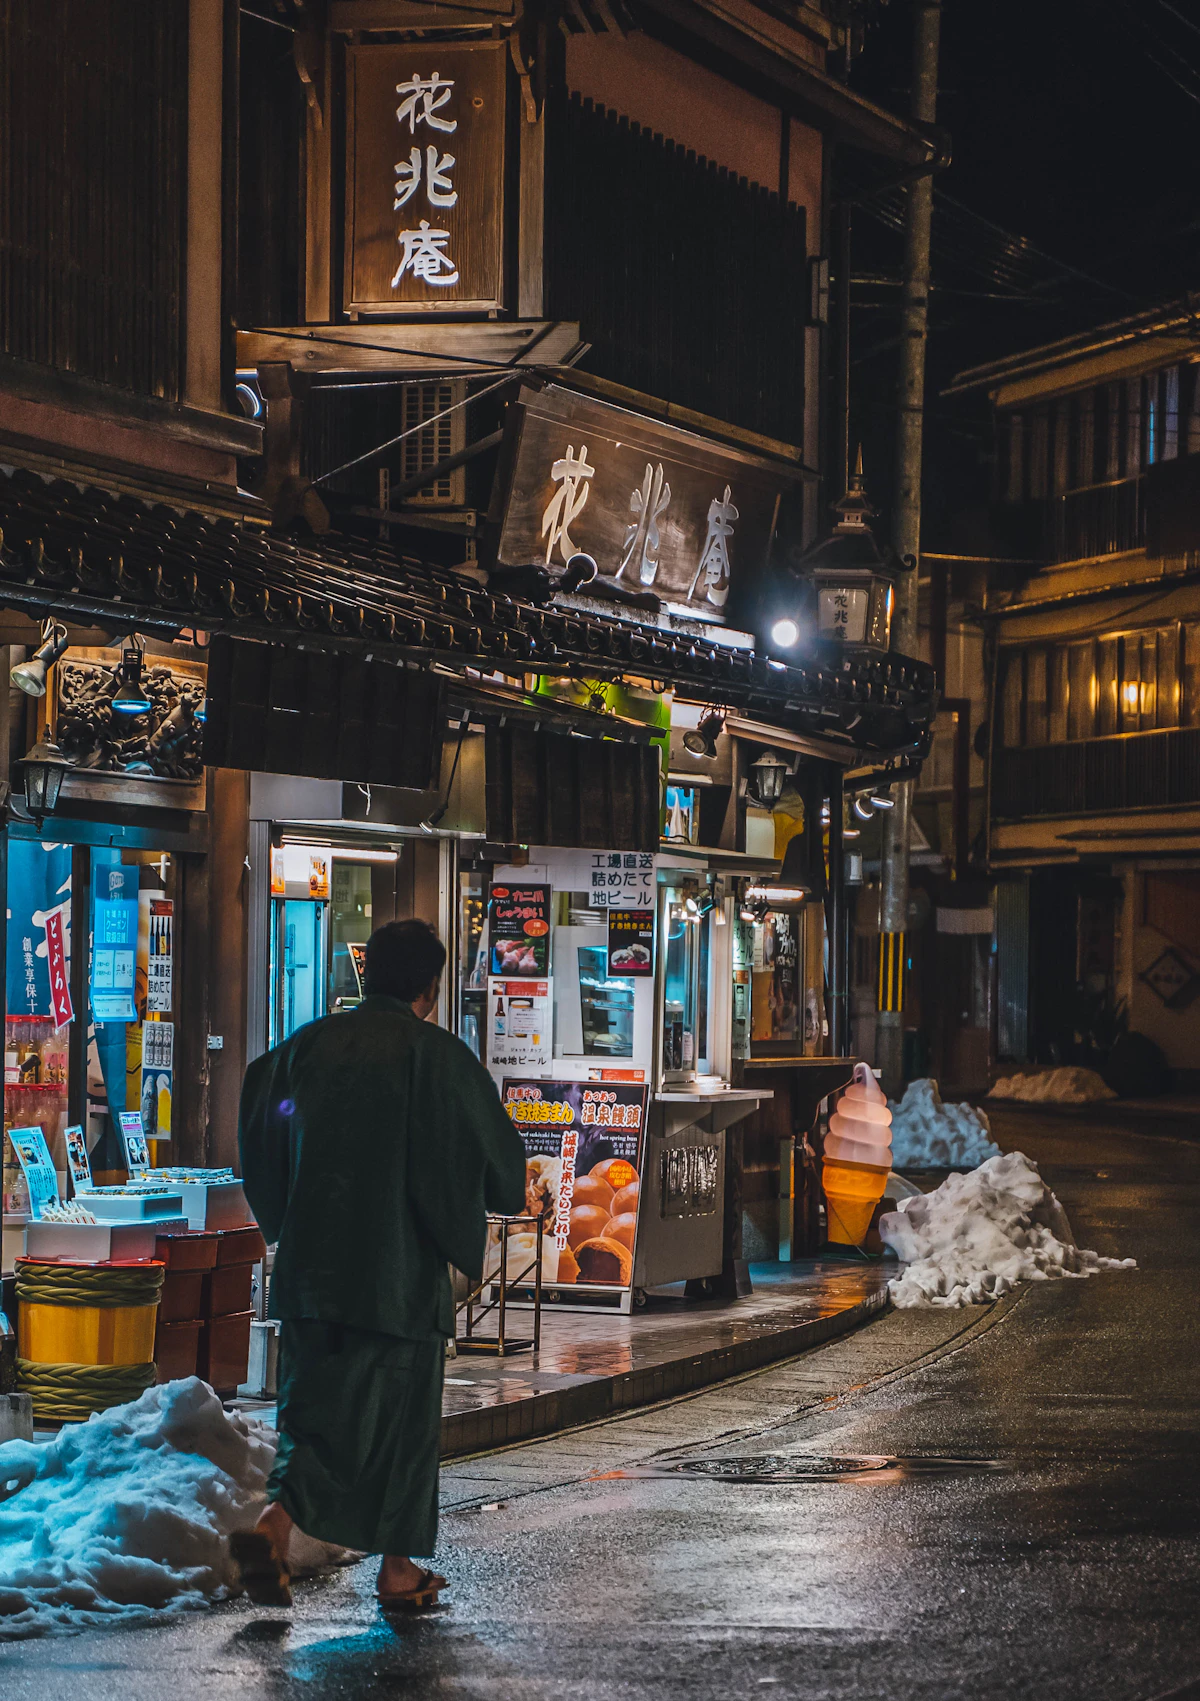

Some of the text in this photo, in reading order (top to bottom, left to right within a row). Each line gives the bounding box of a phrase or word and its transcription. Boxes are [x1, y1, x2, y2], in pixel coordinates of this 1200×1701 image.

[391, 72, 459, 288] 花兆庵
[541, 444, 739, 606] 花兆庵
[591, 853, 653, 868] 工場直送
[592, 871, 652, 887] 詰めたて
[592, 890, 652, 905] 地ビール
[496, 906, 544, 918] しゅうまい
[106, 920, 127, 931] クーポン
[22, 937, 38, 1016] 創業享保十
[148, 963, 171, 978] 工場直送
[584, 1090, 617, 1102] あつあつ
[505, 1100, 574, 1123] すき焼きまん
[582, 1103, 641, 1127] 温泉饅頭
